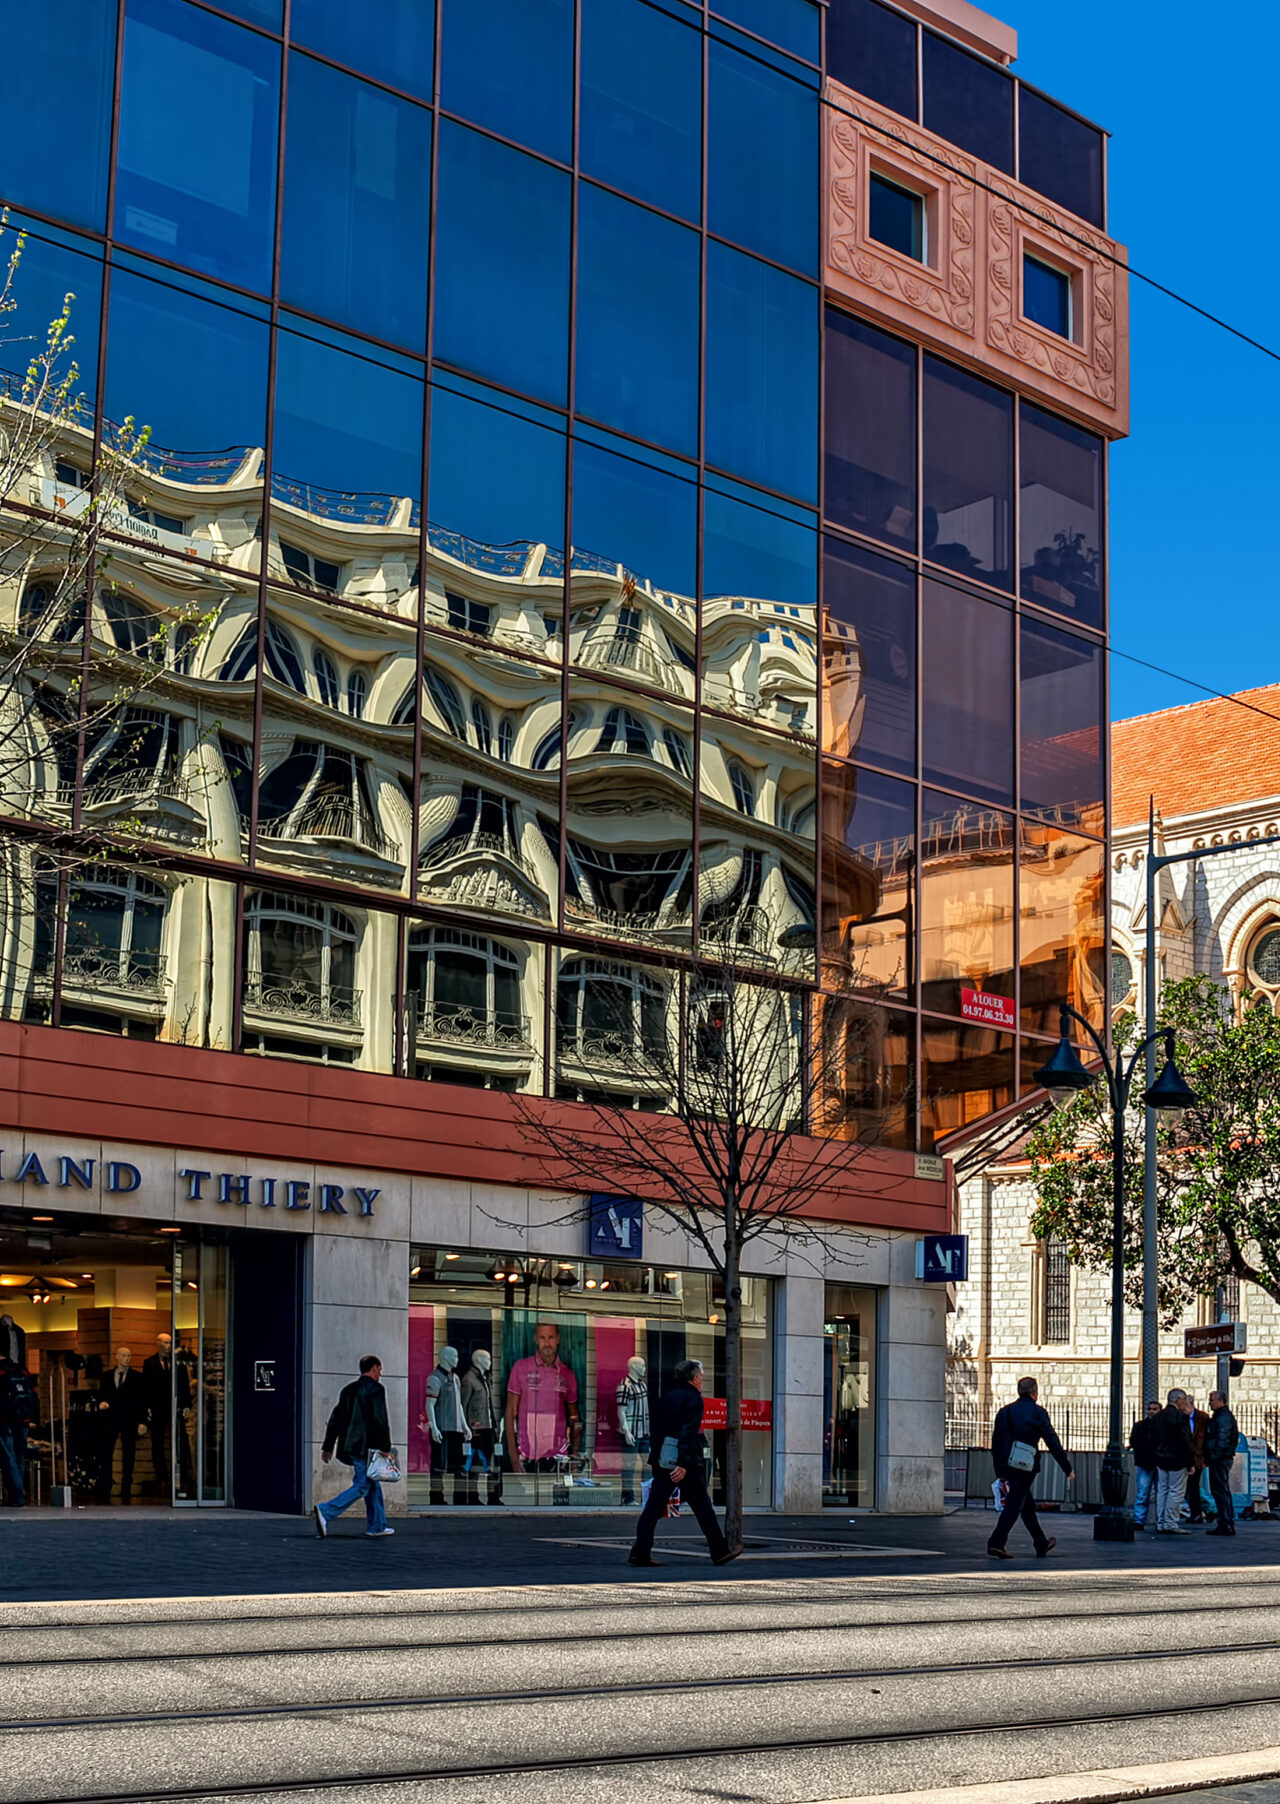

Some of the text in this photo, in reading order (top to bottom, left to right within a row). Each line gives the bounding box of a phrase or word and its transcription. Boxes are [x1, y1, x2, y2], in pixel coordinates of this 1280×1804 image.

[972, 993, 1004, 1009] A LOUER
[0, 1150, 381, 1217] AND THIERY
